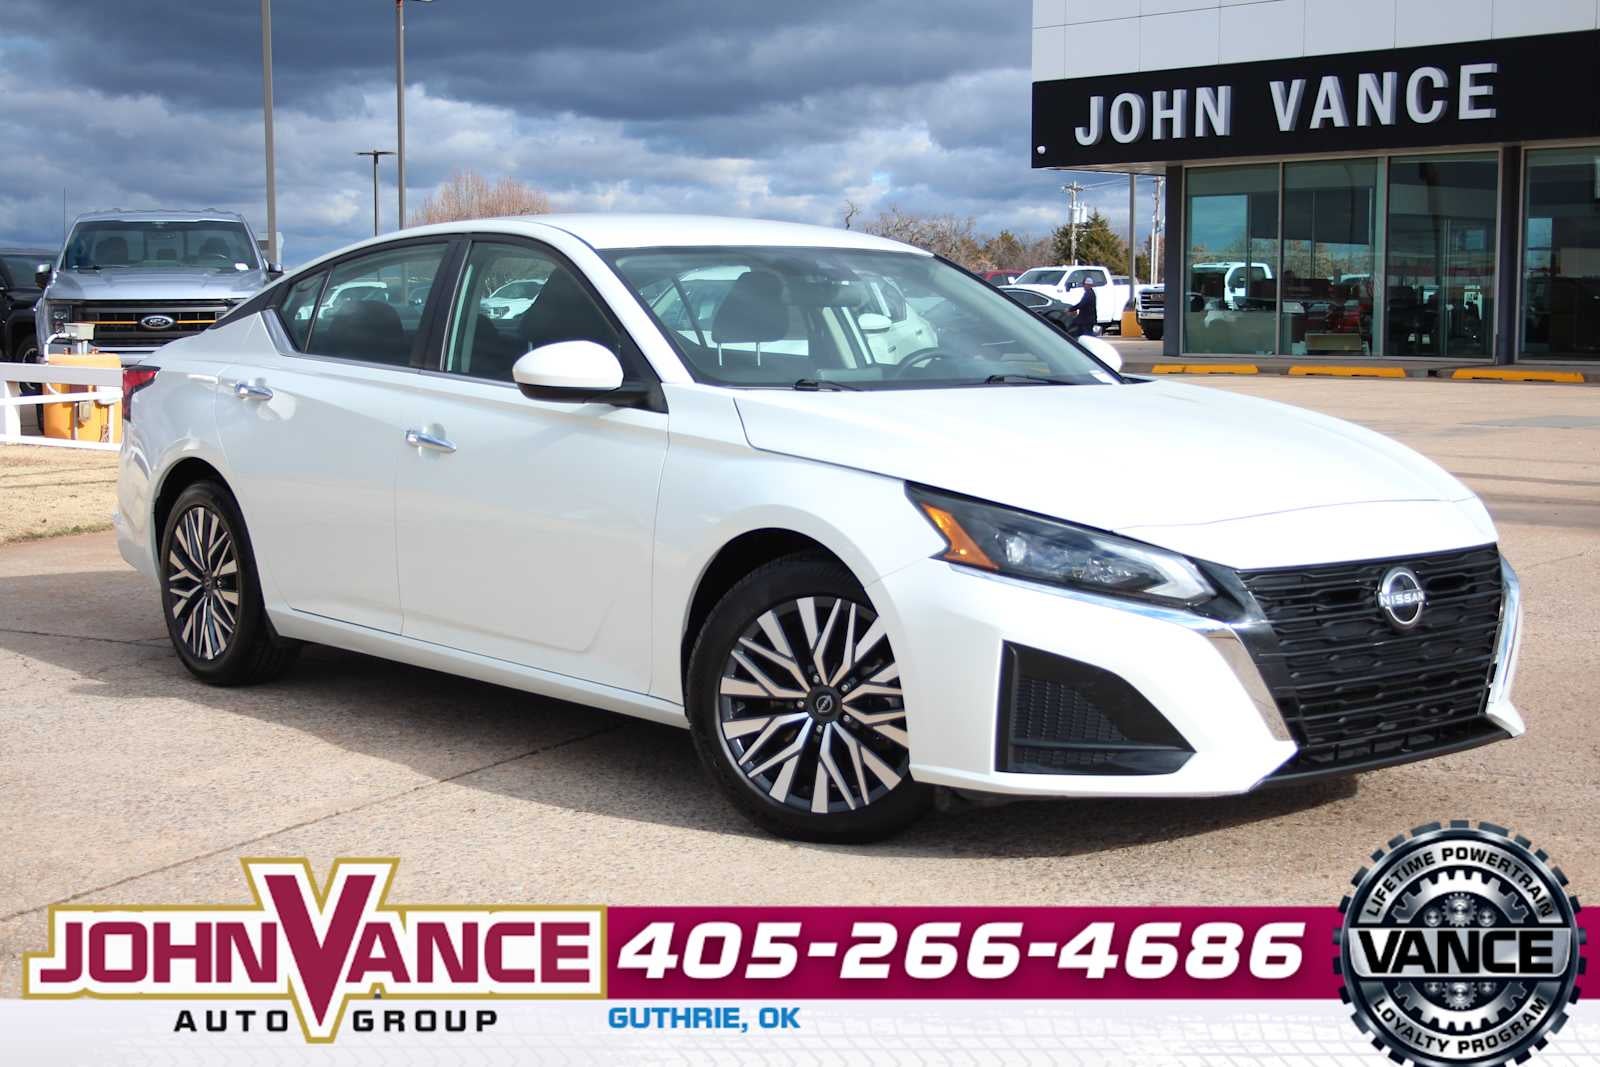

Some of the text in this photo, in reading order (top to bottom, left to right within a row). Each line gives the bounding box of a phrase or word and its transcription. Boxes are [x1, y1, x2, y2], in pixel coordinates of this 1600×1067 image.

[1074, 62, 1499, 147] JOHN VANCE
[1379, 591, 1425, 608] NISSAN
